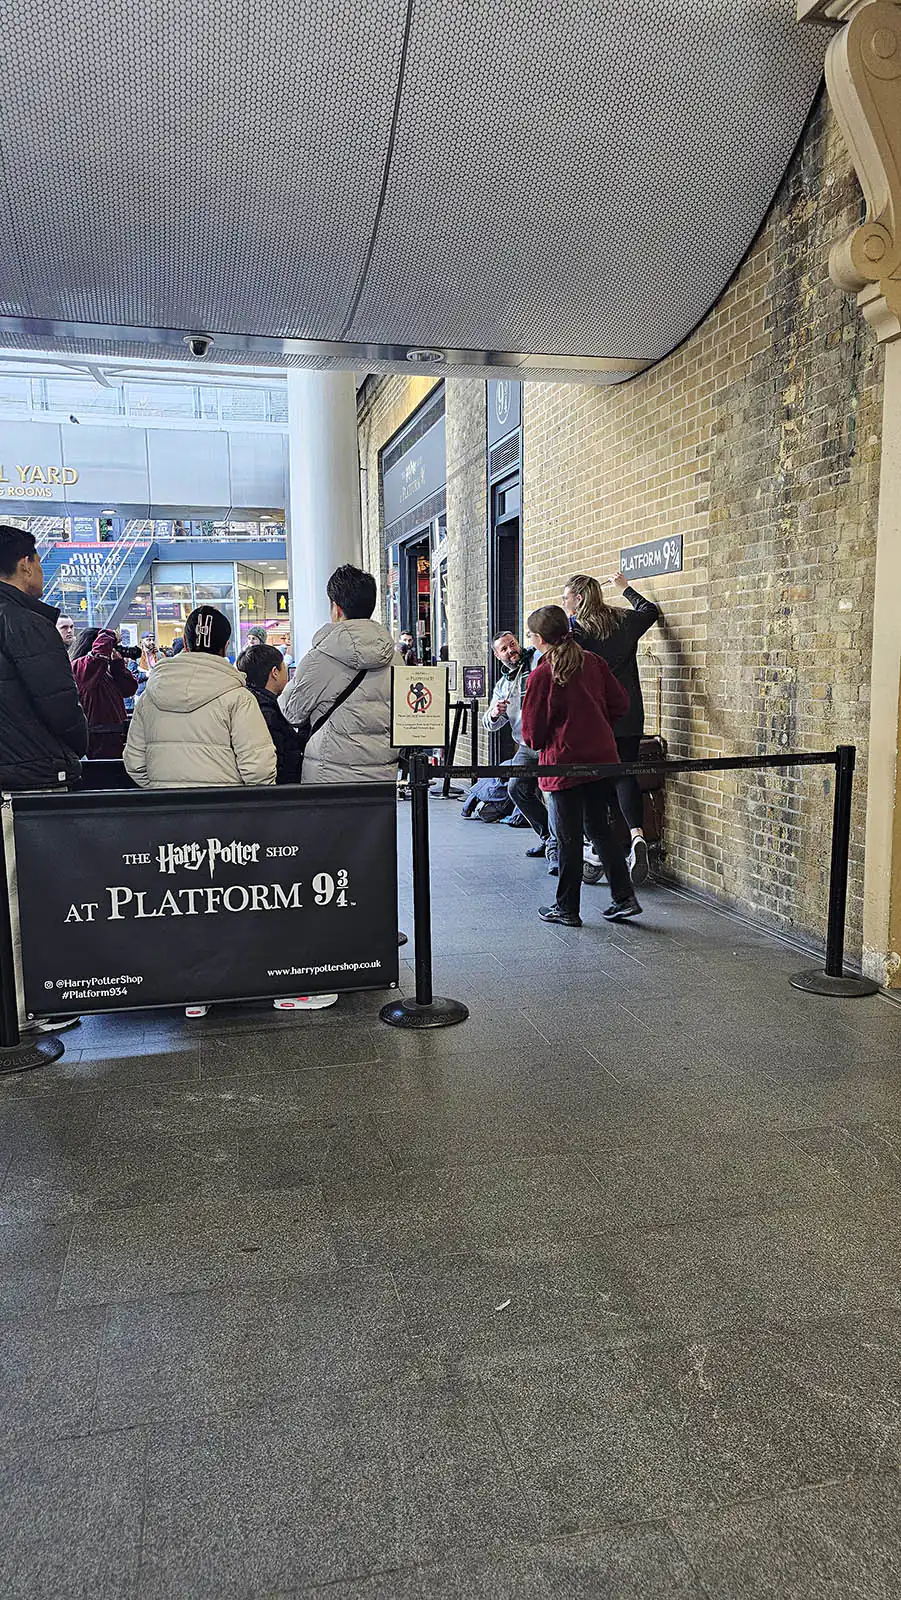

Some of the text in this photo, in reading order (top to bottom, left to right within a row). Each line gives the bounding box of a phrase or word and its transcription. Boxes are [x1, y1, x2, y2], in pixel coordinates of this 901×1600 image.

[15, 464, 79, 486] YARD
[8, 487, 53, 498] ROOMS
[621, 550, 662, 572] PLATFORM
[123, 838, 299, 879] THE Harry Potter SHOP
[64, 903, 98, 923] AT
[105, 882, 303, 920] PLATFORM
[267, 960, 381, 977] www.harrypottershop.co.uk
[56, 974, 143, 989] @HarryPotterShop
[62, 987, 128, 1000] #Platform934
